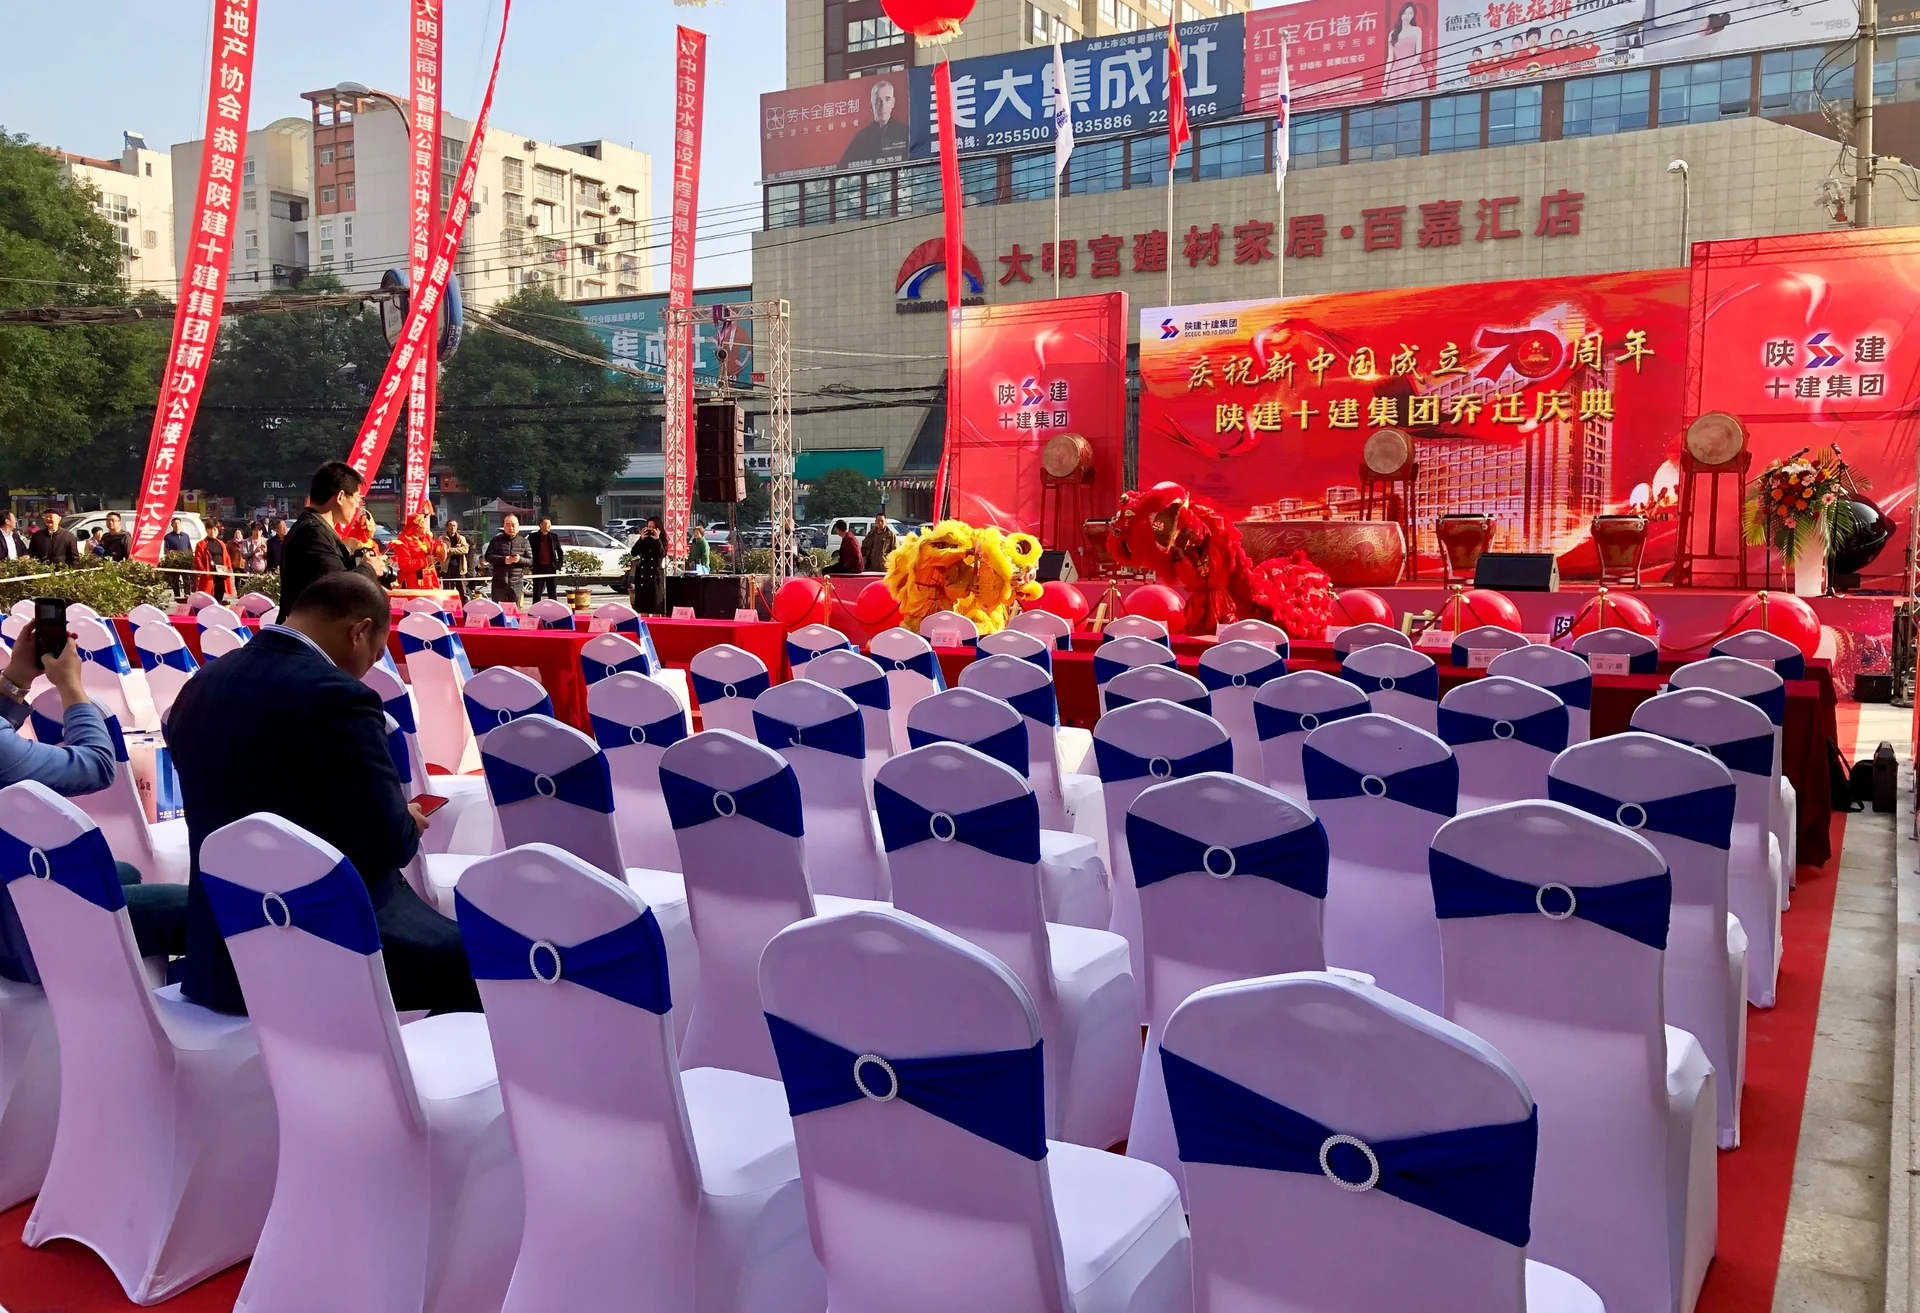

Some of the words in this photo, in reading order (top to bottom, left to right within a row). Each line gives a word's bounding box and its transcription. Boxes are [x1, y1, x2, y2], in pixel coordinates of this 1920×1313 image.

[1087, 35, 1136, 52] A股上市公司
[1180, 22, 1219, 37] 002677
[1253, 11, 1378, 50] 红宝石墙布
[1446, 12, 1481, 32] 德意
[1824, 18, 1851, 30] 1985
[1261, 64, 1294, 76] 美好不就
[930, 37, 1218, 134] 美大集成灶
[787, 98, 860, 123] 劳卡全屋定制
[930, 135, 980, 153] 服热线:
[987, 126, 1050, 146] 2255500
[1071, 114, 1132, 134] 835886
[1149, 102, 1217, 124] 22166
[672, 38, 698, 269] 汉中市汉水建设工程有限公司
[999, 188, 1586, 287] 大明宫建材家居·百嘉汇店
[1184, 318, 1238, 331] 陕建十建集团
[1187, 328, 1654, 392] 庆祝新中国成立70周年
[1765, 374, 1886, 399] 十建集团
[999, 410, 1068, 430] 十建集团
[1215, 388, 1615, 434] 陕建十建集团乔迁庆典
